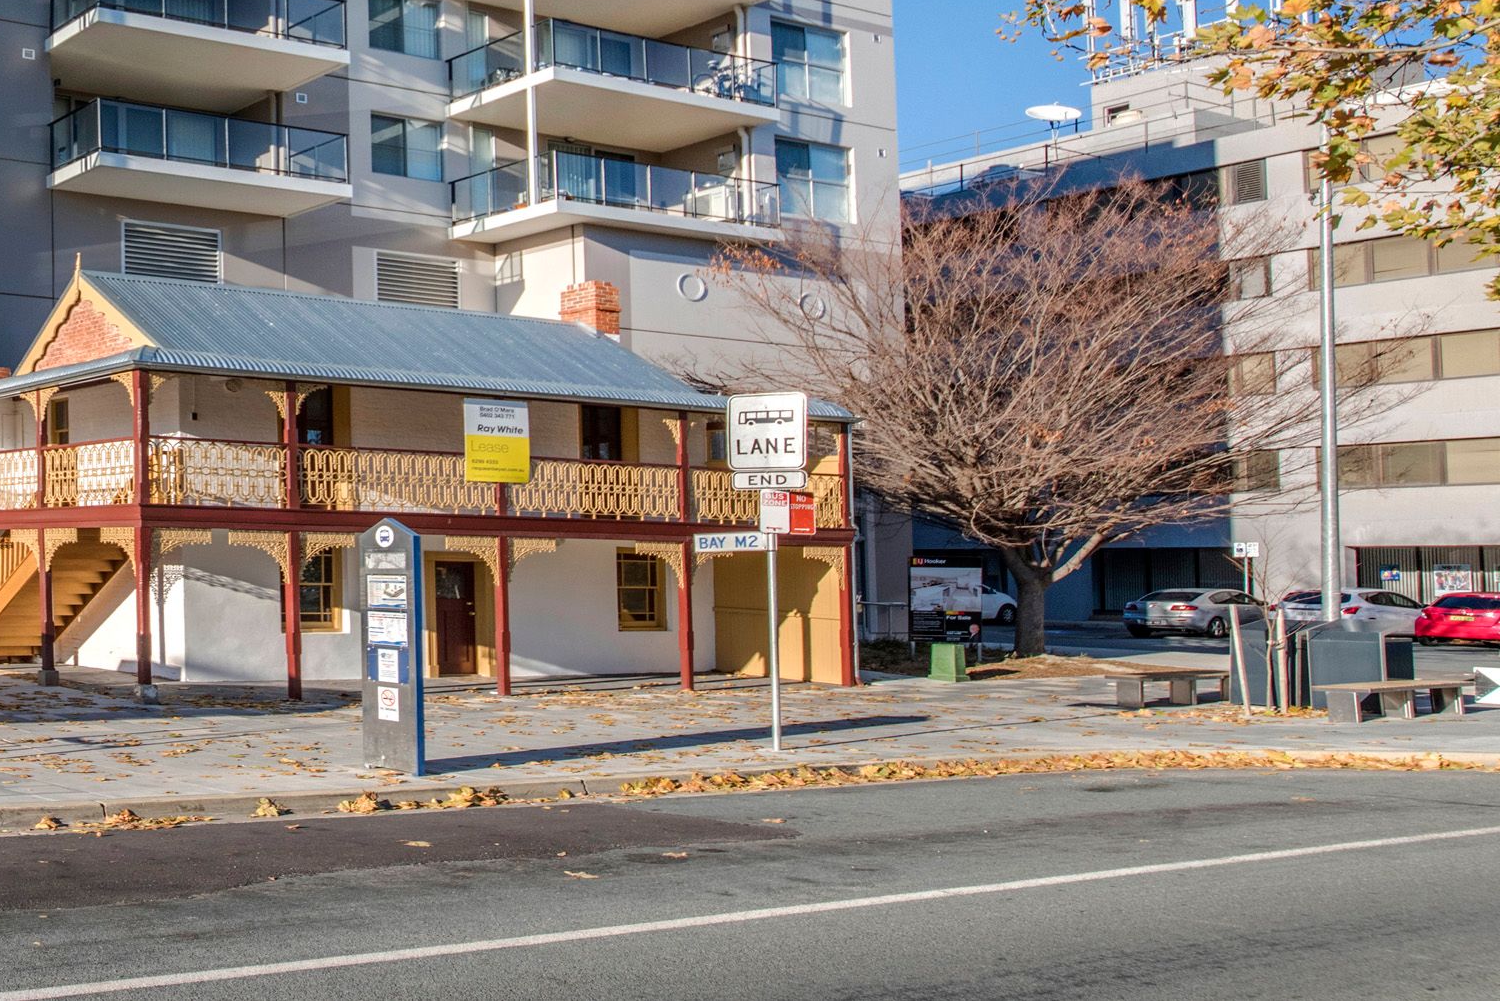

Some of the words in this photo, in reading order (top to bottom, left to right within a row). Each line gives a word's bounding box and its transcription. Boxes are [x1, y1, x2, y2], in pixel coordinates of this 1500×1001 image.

[477, 424, 495, 434] Ray
[497, 426, 524, 435] White
[470, 440, 509, 453] Lease
[736, 438, 795, 455] LANE
[748, 475, 787, 486] END
[699, 537, 725, 549] BAY
[735, 535, 758, 548] M2
